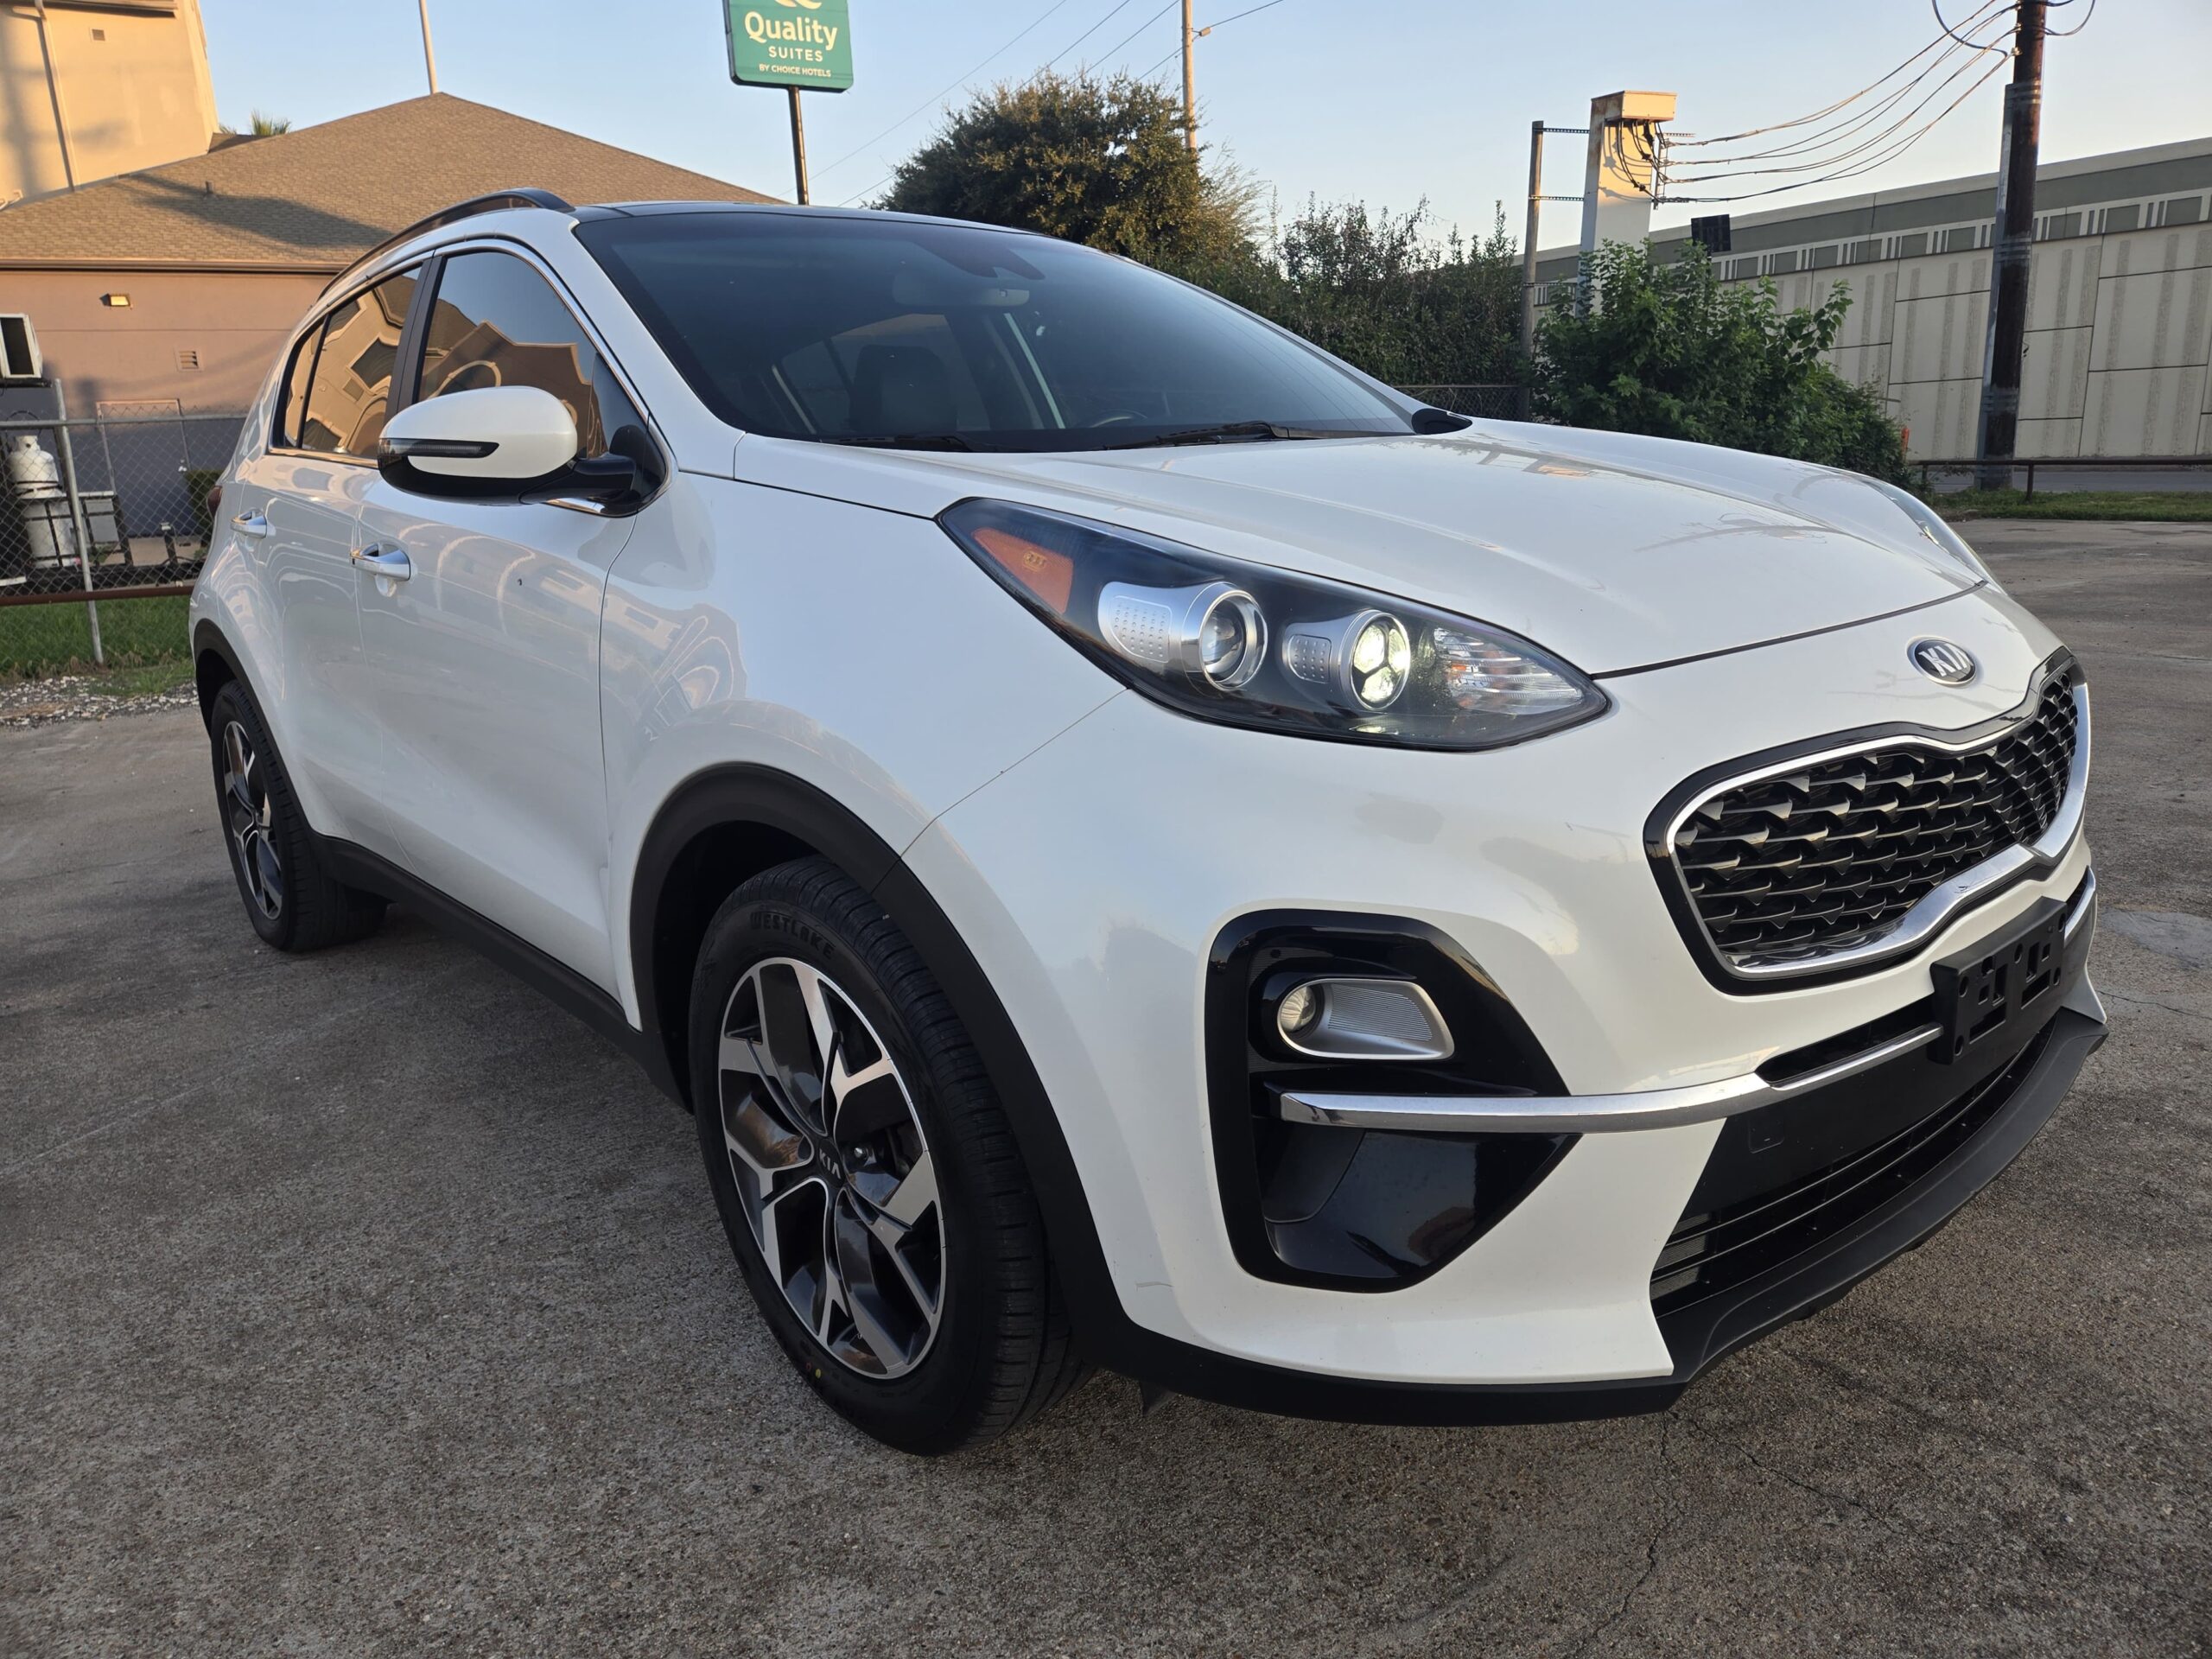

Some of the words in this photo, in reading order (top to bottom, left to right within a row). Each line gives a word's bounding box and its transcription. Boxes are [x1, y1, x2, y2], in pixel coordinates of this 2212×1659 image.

[745, 11, 838, 51] Quality
[759, 63, 770, 72] BY
[771, 65, 800, 75] CHOICE
[802, 67, 831, 78] HOTELS
[768, 46, 823, 62] SUITES
[1917, 643, 1974, 677] KIA
[749, 912, 836, 960] WESTLAKE
[819, 1147, 842, 1180] KIA
